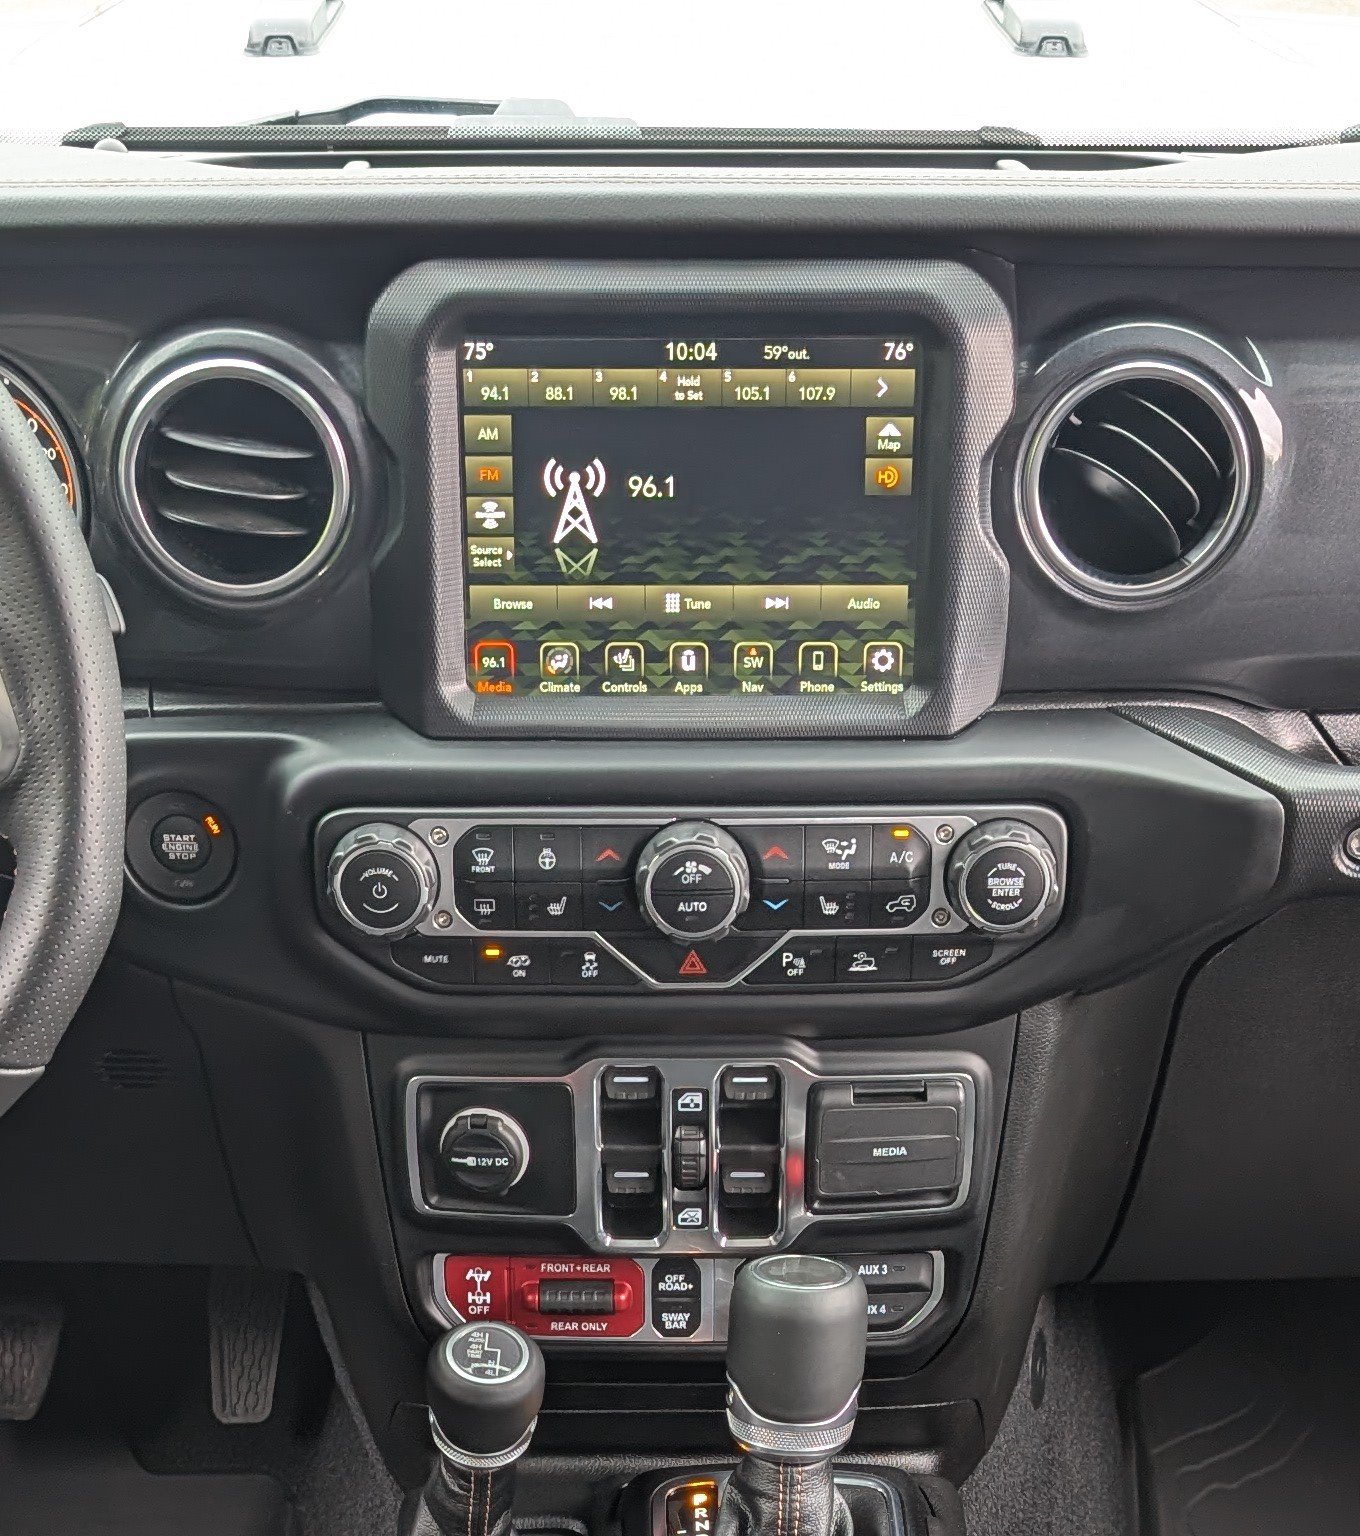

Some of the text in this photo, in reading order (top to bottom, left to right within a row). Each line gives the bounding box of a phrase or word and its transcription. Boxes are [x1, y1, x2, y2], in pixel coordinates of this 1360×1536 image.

[463, 342, 494, 361] 75°
[665, 341, 718, 361] 10:04
[883, 342, 914, 361] 76°
[466, 370, 473, 382] 1
[530, 370, 539, 382] 2
[595, 370, 603, 382] 3
[658, 370, 667, 382] 4
[677, 374, 701, 387] Hold
[723, 370, 732, 382] 5
[788, 370, 796, 382] 6
[480, 386, 509, 401] 94.1
[545, 386, 574, 401] 88.1
[609, 386, 638, 401] 98.1
[674, 389, 704, 401] to Set
[734, 386, 770, 401] 105.1
[798, 386, 836, 401] 107.9
[477, 427, 499, 441] AM
[877, 439, 901, 452] Map
[478, 469, 500, 482] FM
[627, 475, 675, 498] 96.1
[470, 545, 503, 556] Source
[472, 557, 502, 568] Select
[493, 597, 534, 610] Browse
[684, 597, 712, 610] Tune
[846, 597, 881, 610] Audio
[481, 656, 506, 668] 96.1
[743, 656, 764, 668] SW
[477, 681, 513, 693] Media
[539, 681, 581, 693] Climate
[602, 681, 648, 693] Controls
[674, 681, 703, 695] Apps
[741, 681, 764, 693] Nav
[799, 681, 835, 693] Phone
[860, 681, 904, 695] Settings
[162, 833, 196, 842] START
[161, 842, 199, 852] ENGINE
[168, 852, 197, 860] STOP
[889, 851, 914, 863] A/C
[471, 865, 496, 874] FRONT
[828, 861, 851, 870] MODE
[997, 862, 1018, 871] TUNE
[362, 867, 394, 878] VOLUME
[681, 873, 703, 884] OFF
[987, 876, 1025, 886] BROWSE
[991, 888, 1021, 897] ENTER
[677, 901, 708, 912] AUTO
[990, 901, 1020, 911] SCROLL
[932, 948, 966, 958] SCREEN
[423, 955, 449, 964] MUTE
[782, 953, 794, 967] P
[939, 957, 957, 965] OFF
[512, 969, 527, 978] ON
[581, 969, 599, 978] OFF
[787, 968, 804, 977] OFF
[872, 1146, 908, 1157] MEDIA
[477, 1157, 509, 1167] 12V DC
[857, 1264, 888, 1275] AUX 3
[664, 1274, 686, 1283] OFF
[468, 1306, 490, 1315] OFF
[879, 1304, 886, 1314] 4
[661, 1313, 691, 1322] SWAY
[550, 1322, 608, 1331] REAR ONLY
[664, 1320, 687, 1330] BAR
[693, 1493, 707, 1505] P
[695, 1508, 708, 1518] R
[696, 1520, 709, 1531] N
